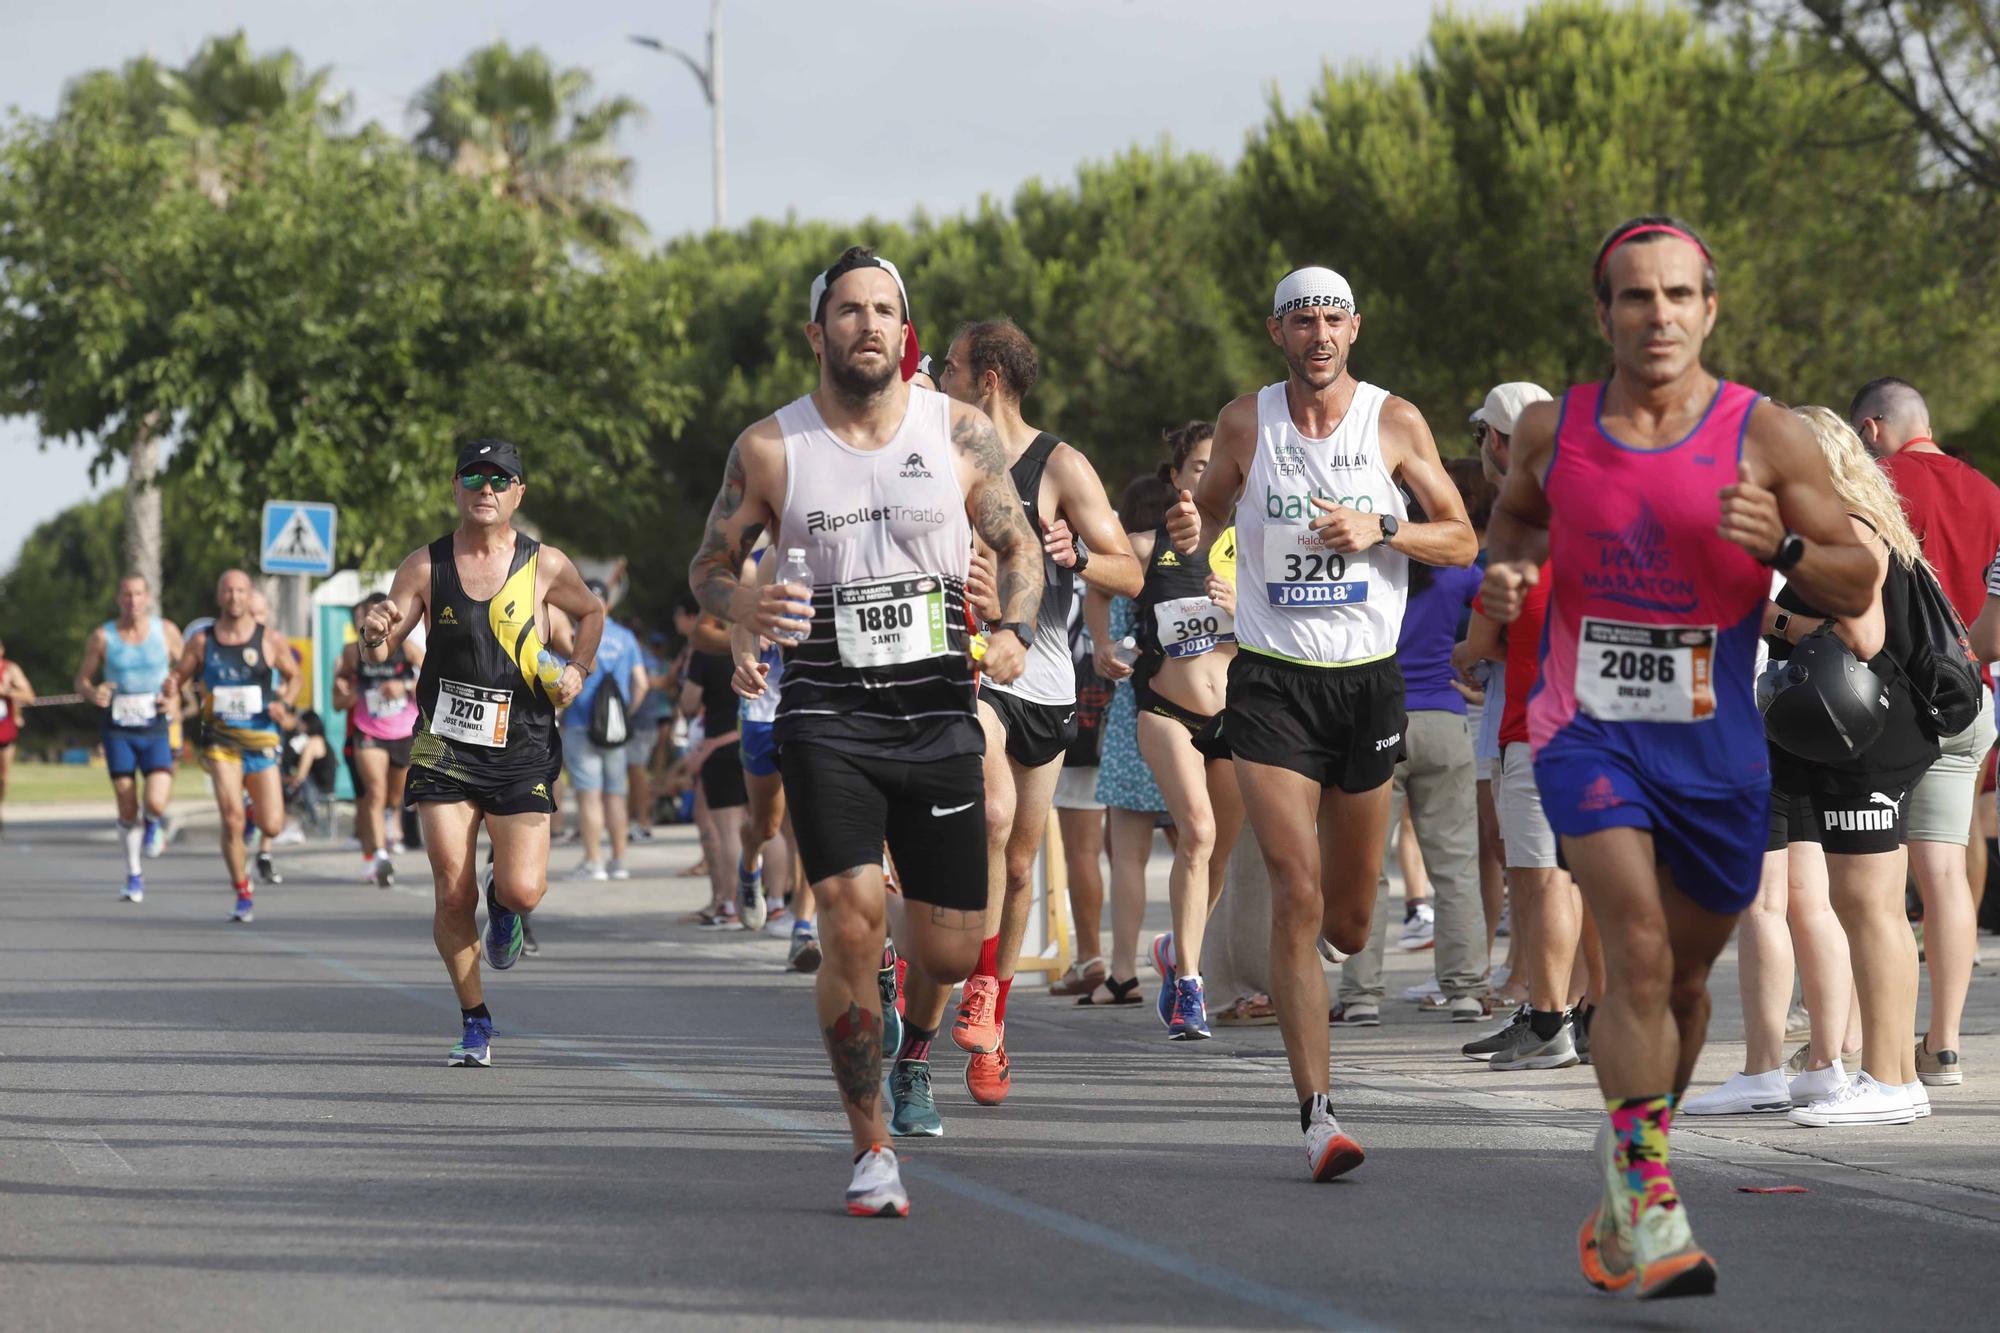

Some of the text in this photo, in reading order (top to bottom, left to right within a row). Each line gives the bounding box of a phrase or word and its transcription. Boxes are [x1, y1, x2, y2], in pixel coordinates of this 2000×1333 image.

[1275, 444, 1306, 455] bathco
[1276, 455, 1305, 464] running
[1274, 463, 1306, 477] TEAM
[1284, 553, 1346, 582] 320
[856, 602, 913, 633] 1880
[1172, 616, 1219, 641] 390
[871, 633, 901, 646] SANTI
[1600, 649, 1676, 684] 2086
[450, 697, 485, 722] 1270
[442, 716, 484, 731] JOSE MANUEL
[1823, 809, 1894, 831] PUMA
